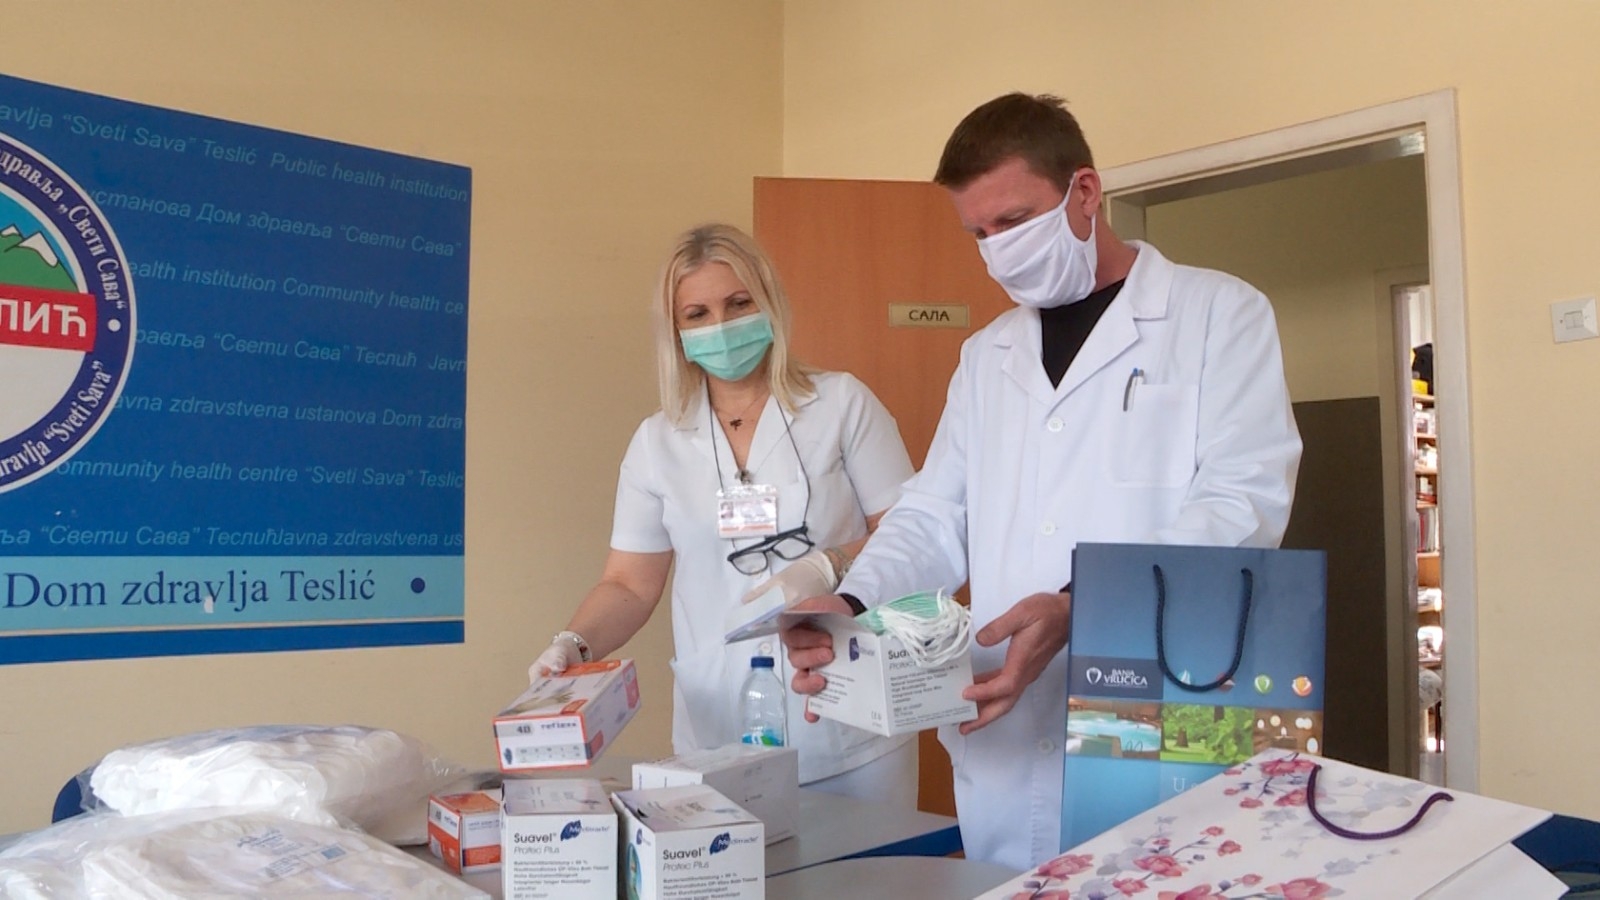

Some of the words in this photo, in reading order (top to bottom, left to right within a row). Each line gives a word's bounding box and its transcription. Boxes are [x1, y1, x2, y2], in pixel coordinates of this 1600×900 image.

[203, 138, 257, 166] Teslić
[270, 152, 327, 179] Public
[332, 162, 386, 188] health
[390, 173, 468, 202] institution
[195, 202, 241, 226] Дом
[247, 211, 333, 239] здравља
[182, 265, 277, 293] institution
[282, 277, 385, 309] Community
[388, 291, 440, 312] health
[908, 309, 950, 321] САЛА
[169, 396, 289, 419] zdravstvena
[295, 405, 377, 425] ustanova
[382, 408, 422, 428] Dom
[427, 415, 463, 430] zdra
[170, 460, 232, 481] health
[238, 464, 298, 483] centre
[333, 528, 439, 547] zdravstvena
[3, 572, 107, 609] Dom
[121, 569, 270, 613] zdravlja
[280, 568, 376, 602] Teslić
